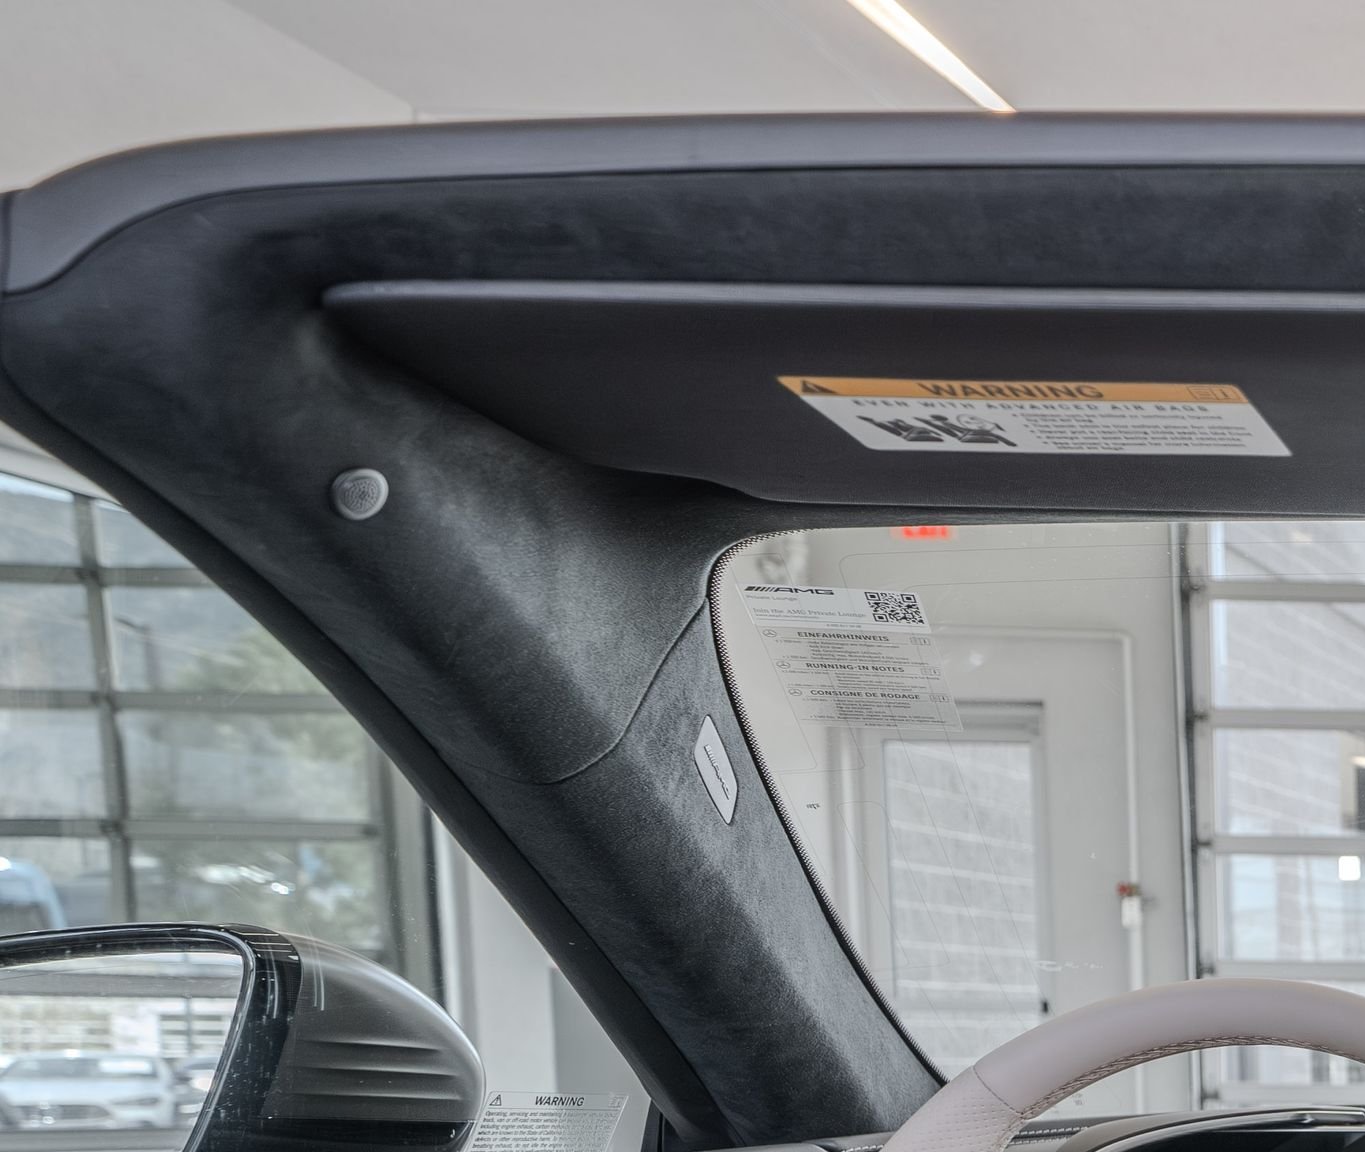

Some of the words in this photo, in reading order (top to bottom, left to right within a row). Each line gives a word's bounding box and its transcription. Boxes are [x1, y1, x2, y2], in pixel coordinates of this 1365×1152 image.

[917, 382, 1103, 399] WARNING
[852, 399, 910, 407] EVEN
[918, 401, 975, 409] WITH
[985, 402, 1099, 411] ADVANCED
[1110, 403, 1145, 411] AIR
[1156, 404, 1210, 412] BAGS
[773, 586, 835, 595] AMG
[838, 611, 867, 619] Lounge
[797, 631, 888, 642] EINFAHRHINWEIS
[805, 662, 870, 672] RUNNING-IN
[871, 664, 905, 673] NOTES
[810, 689, 864, 698] CONSIGNE
[865, 691, 878, 699] DE
[879, 691, 921, 701] RODAGE
[534, 1096, 585, 1107] WARNING
